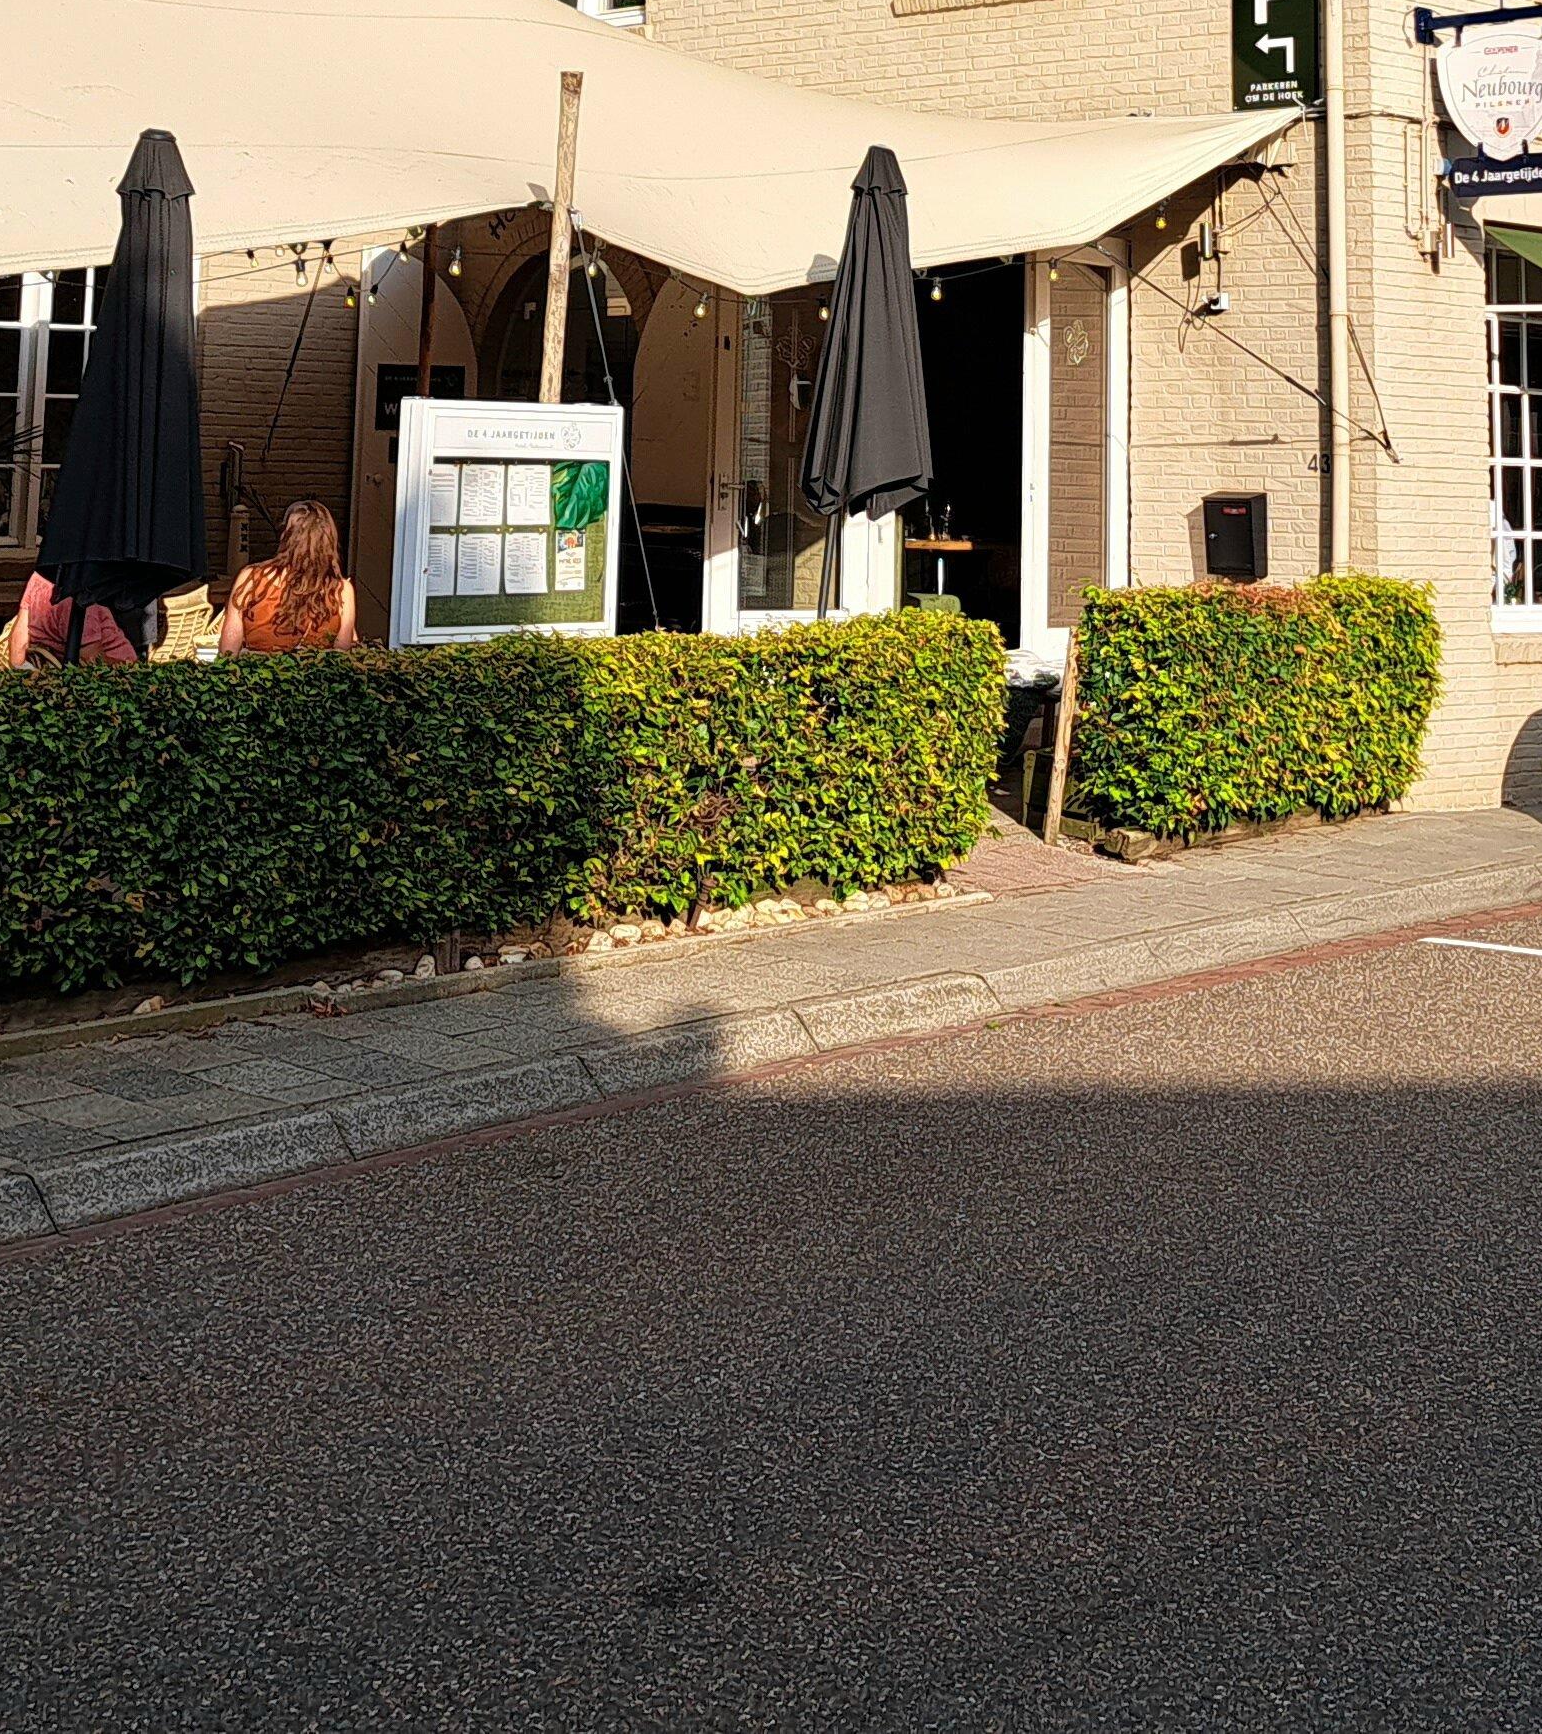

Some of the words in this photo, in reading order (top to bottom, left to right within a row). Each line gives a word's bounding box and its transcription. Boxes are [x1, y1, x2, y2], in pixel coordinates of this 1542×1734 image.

[1250, 80, 1298, 92] PARKEREN
[1461, 75, 1542, 104] Neubourg
[1244, 94, 1260, 103] OM
[1262, 93, 1275, 101] DE
[1278, 91, 1304, 100] HOEK
[1454, 171, 1470, 184] De
[1472, 171, 1479, 183] 4
[1307, 453, 1331, 474] 43
